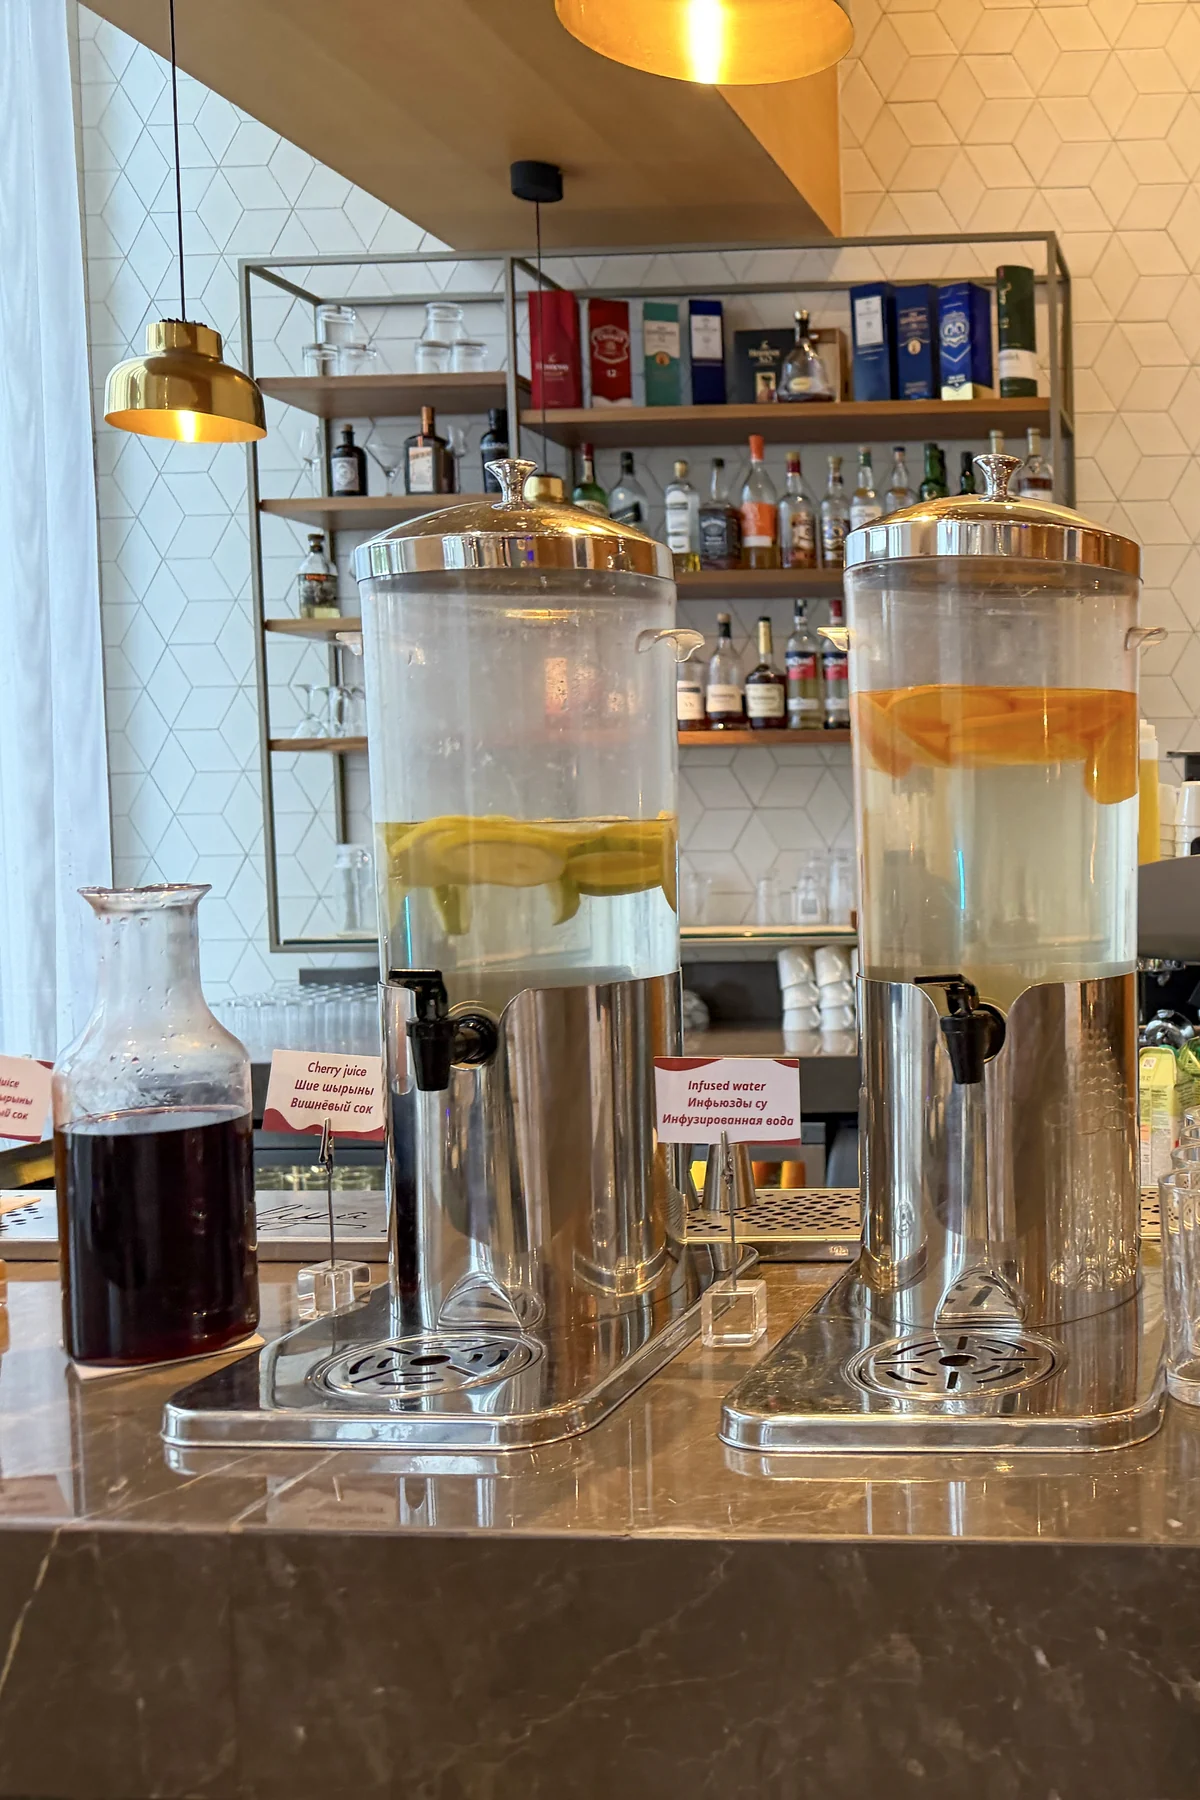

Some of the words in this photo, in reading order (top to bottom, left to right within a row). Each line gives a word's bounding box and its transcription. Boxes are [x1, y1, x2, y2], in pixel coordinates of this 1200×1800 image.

[307, 1061, 342, 1078] Cherry
[342, 1064, 367, 1079] juice
[294, 1079, 320, 1092] Шие
[322, 1083, 375, 1096] шырыны
[688, 1080, 730, 1092] Infused
[732, 1082, 766, 1091] water
[290, 1097, 352, 1112] Вишнёвый
[353, 1104, 374, 1114] сок
[687, 1097, 752, 1110] Инфьюзды
[755, 1100, 768, 1111] су
[12, 1110, 29, 1120] сок
[662, 1114, 763, 1127] Инфузированная
[765, 1115, 794, 1126] вода
